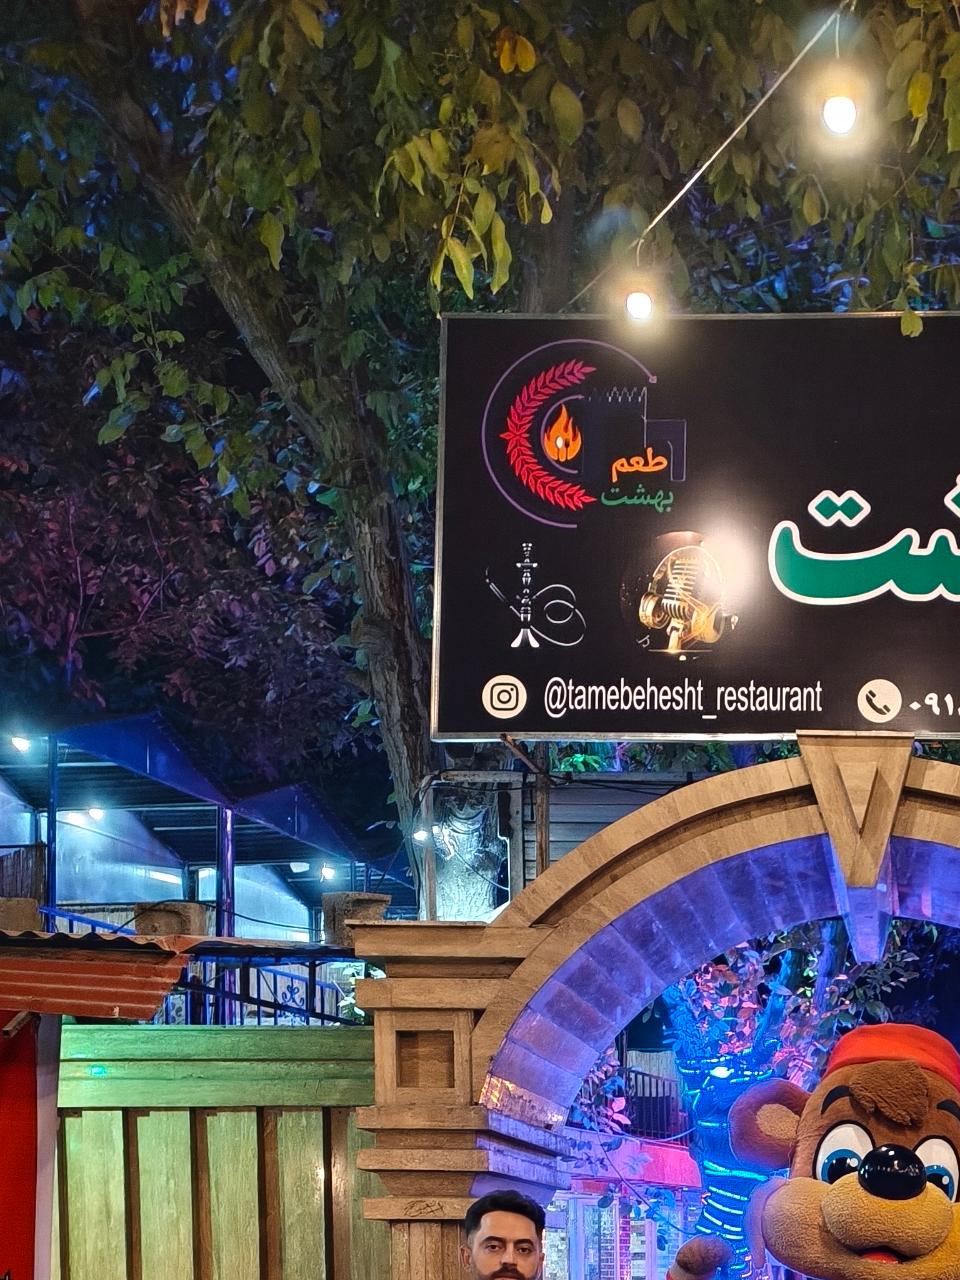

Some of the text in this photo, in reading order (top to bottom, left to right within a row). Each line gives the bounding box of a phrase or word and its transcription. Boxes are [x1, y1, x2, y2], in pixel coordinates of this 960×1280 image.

[611, 447, 668, 482] طعم
[601, 484, 674, 513] بهشت
[544, 676, 823, 720] @tamebehesht_restaurant
